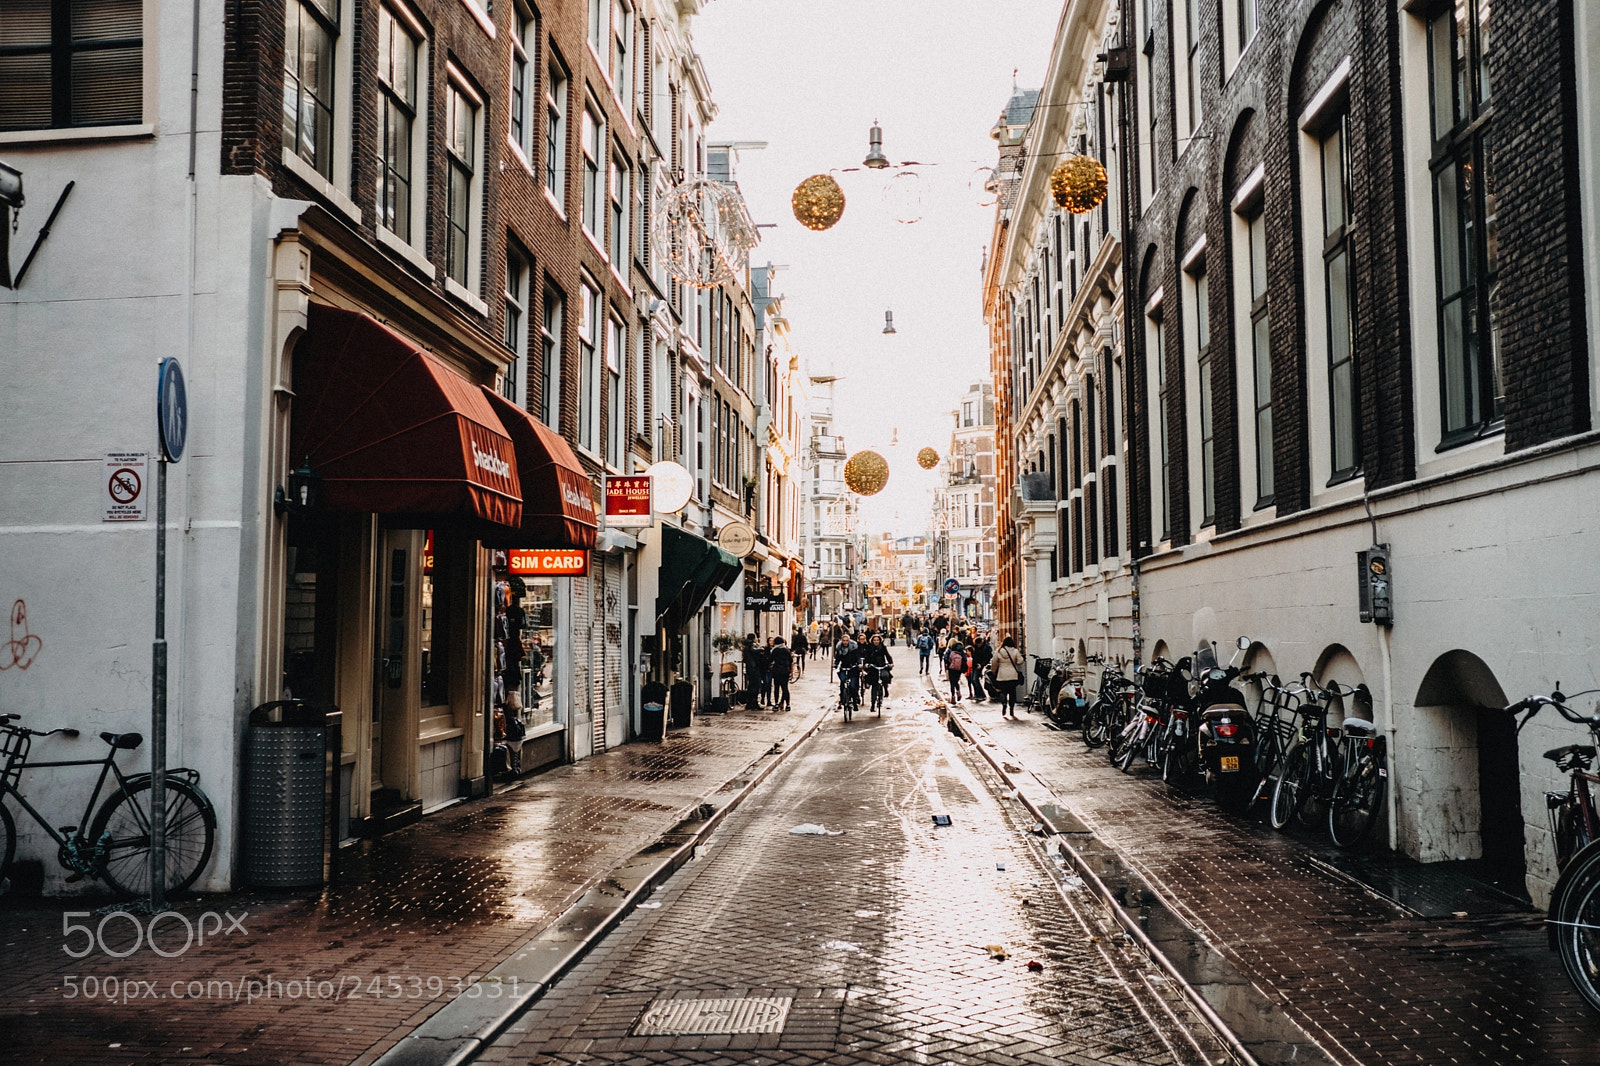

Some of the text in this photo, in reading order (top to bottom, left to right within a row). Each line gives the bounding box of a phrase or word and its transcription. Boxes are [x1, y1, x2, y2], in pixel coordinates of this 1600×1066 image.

[471, 440, 510, 479] Snackbar
[606, 488, 623, 496] JADE
[511, 556, 584, 569] SIM CARD
